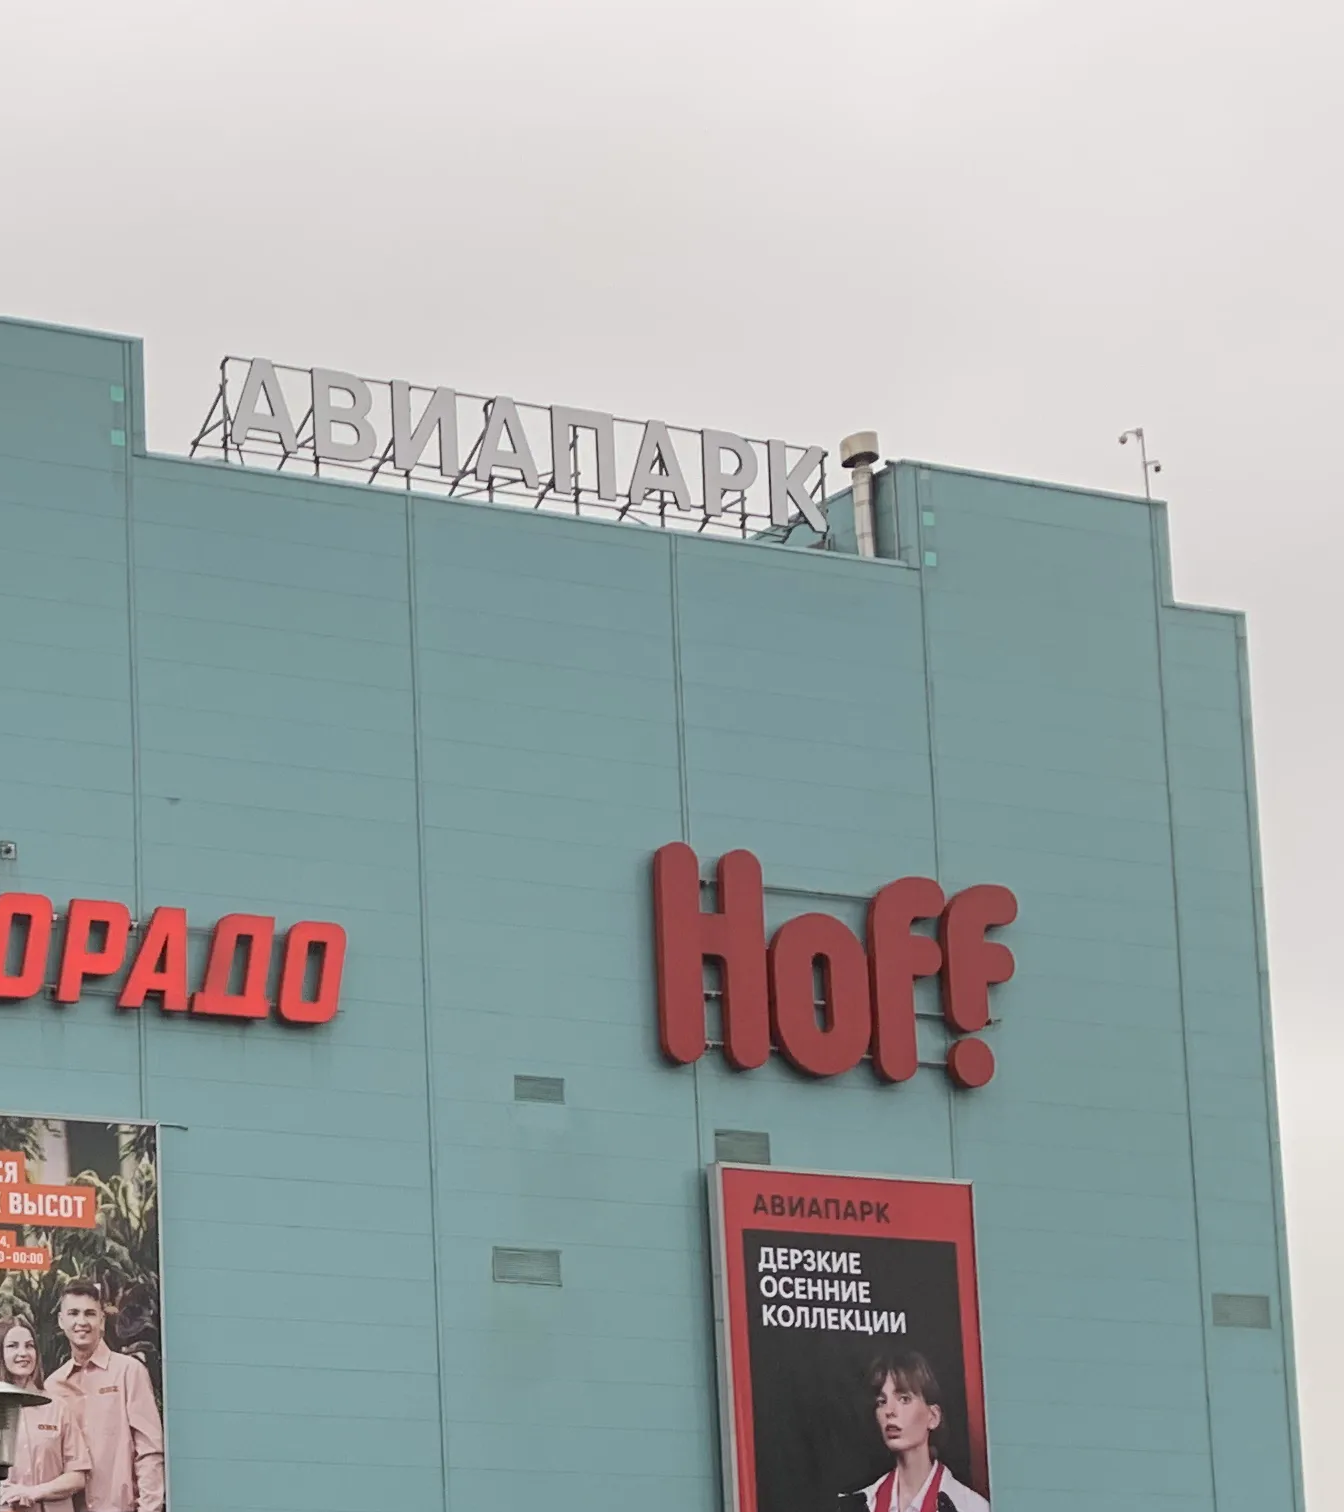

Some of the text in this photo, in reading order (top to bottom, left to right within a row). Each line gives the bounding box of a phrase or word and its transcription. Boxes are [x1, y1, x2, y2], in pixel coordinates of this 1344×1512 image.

[230, 357, 828, 534] АВИАПАРК
[9, 1192, 87, 1218] ВЫСОТ
[753, 1194, 890, 1223] АВИАПАРК
[758, 1247, 861, 1274] ДЕРЗКИЕ
[760, 1276, 871, 1303] ОСЕННИЕ
[763, 1304, 906, 1335] КОЛЛЕКЦИИ
